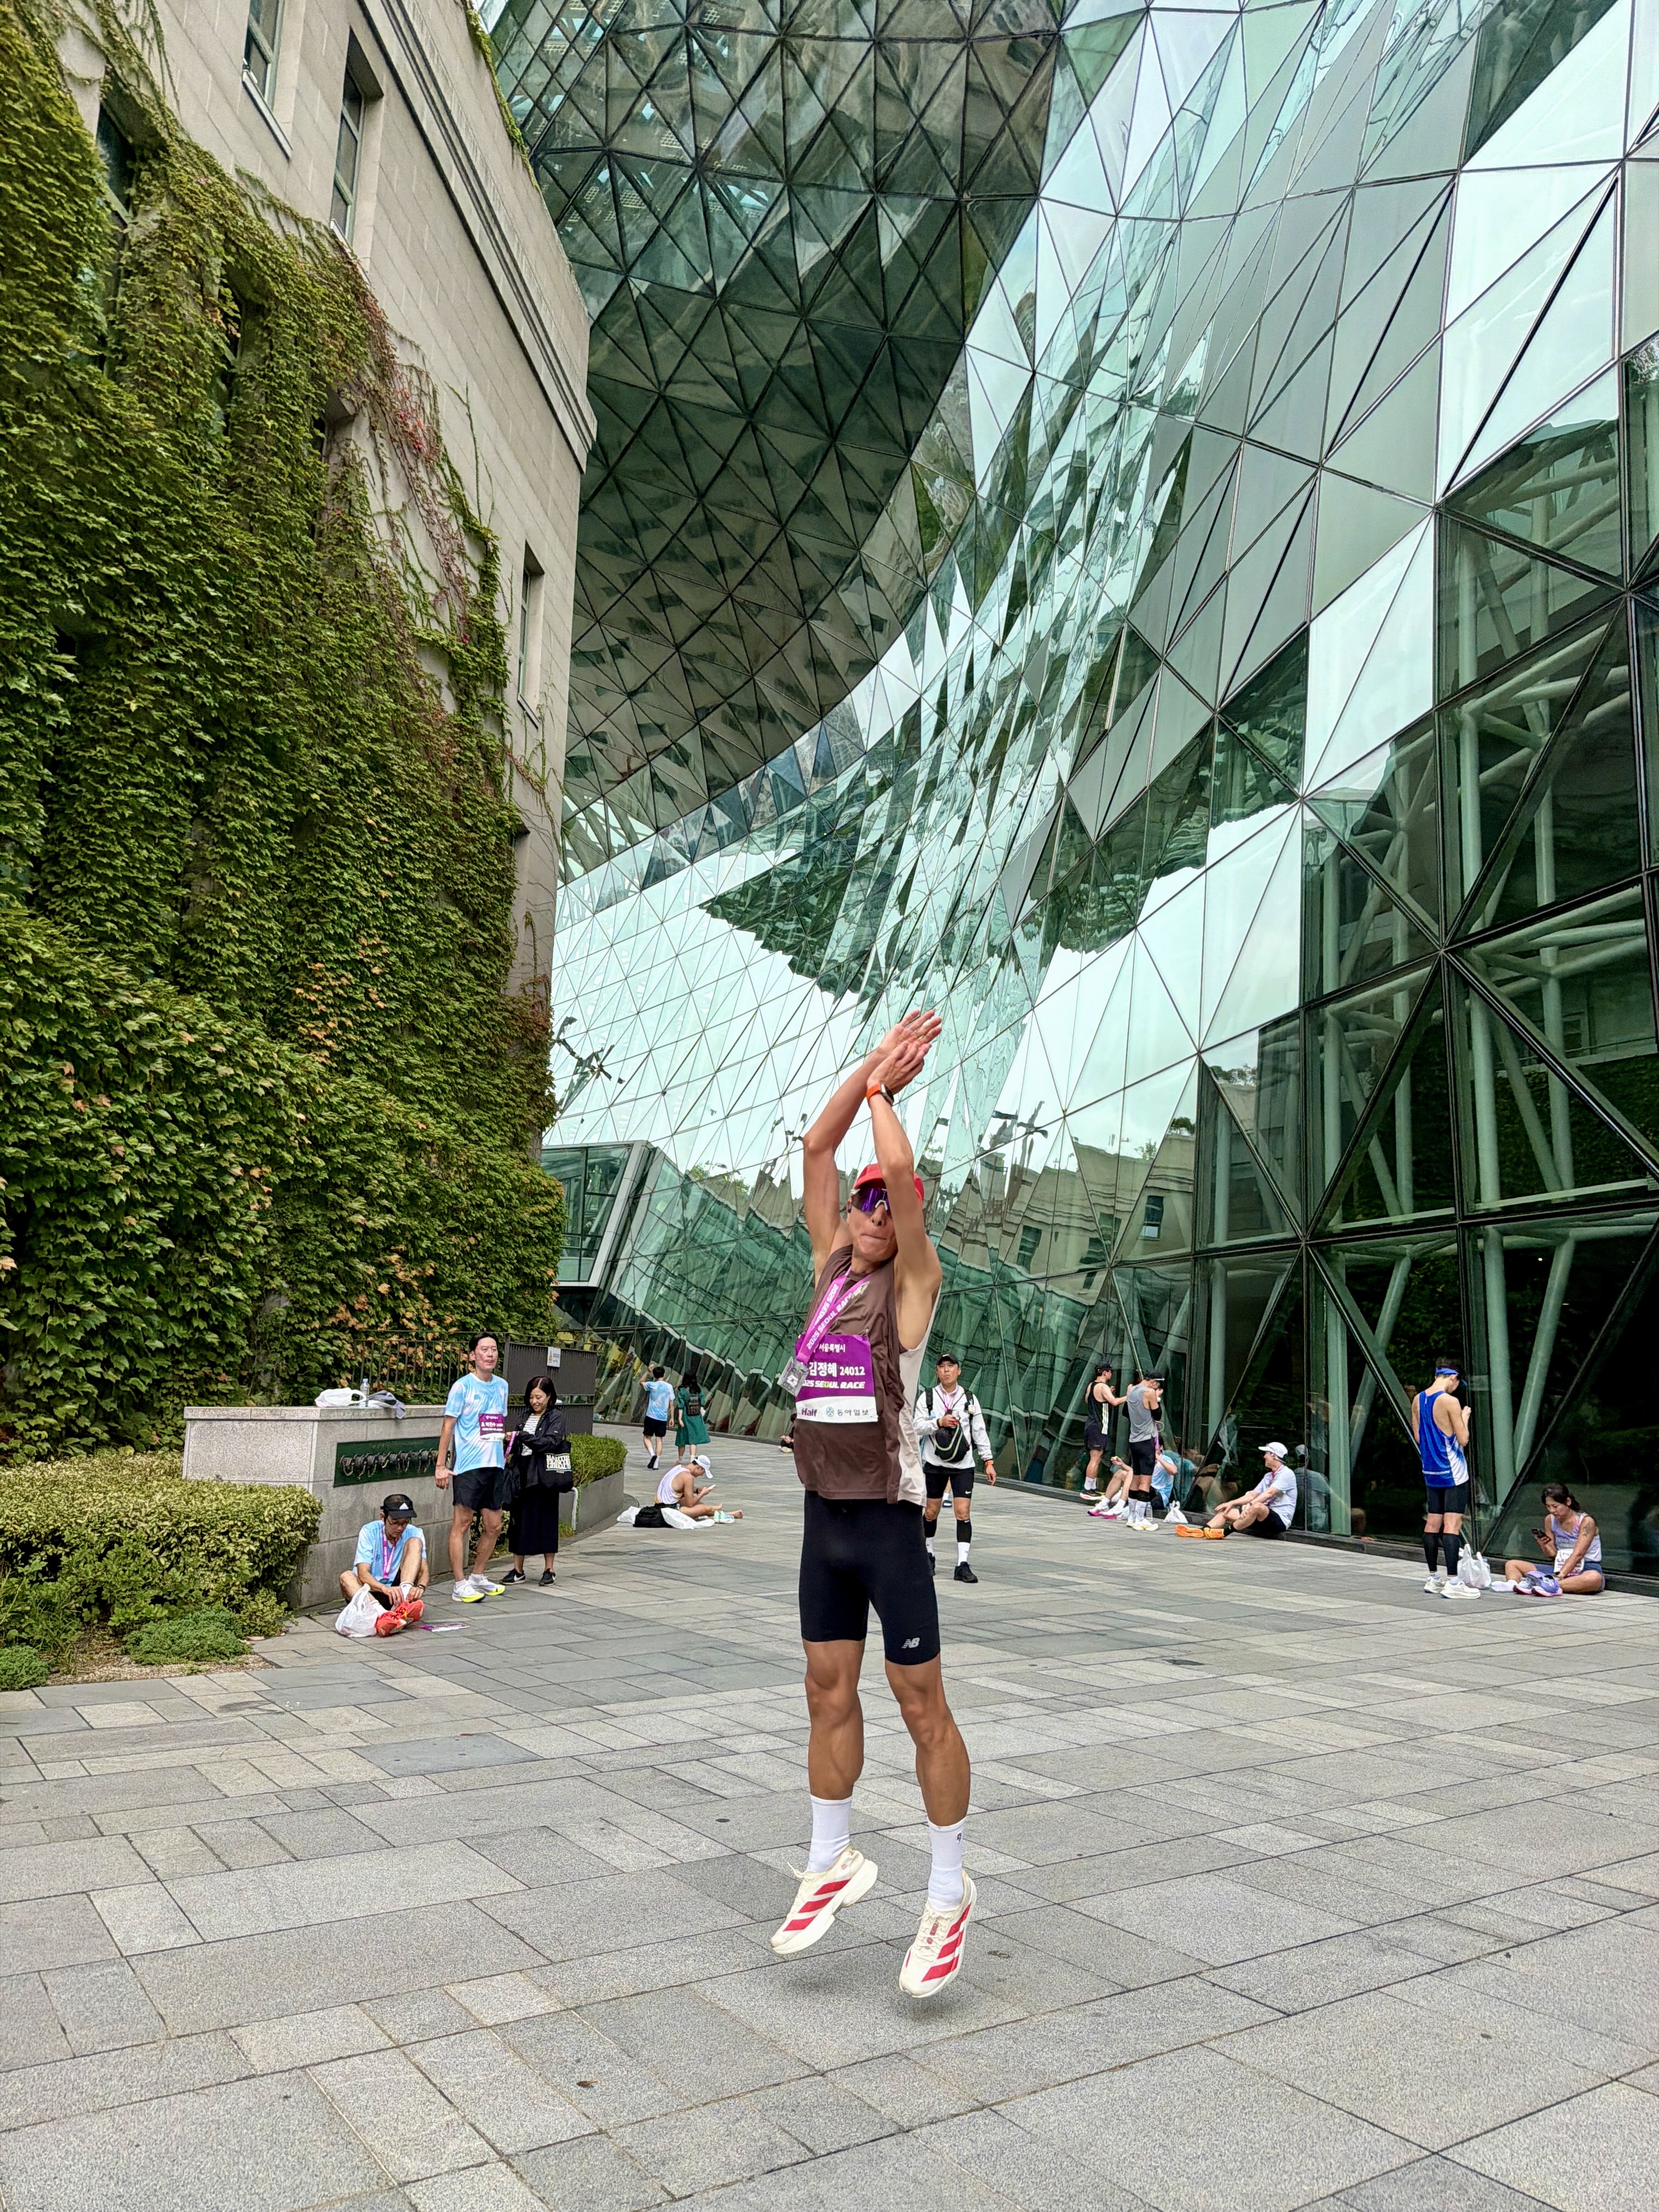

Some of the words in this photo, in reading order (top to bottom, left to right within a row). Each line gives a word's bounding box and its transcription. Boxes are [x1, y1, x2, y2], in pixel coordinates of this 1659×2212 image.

[826, 1284, 839, 1304] 2025
[806, 1330, 820, 1350] 2025
[817, 1311, 838, 1333] SEOUL
[819, 1344, 845, 1353] 서울특별시
[809, 1361, 837, 1377] 김정혜
[839, 1367, 865, 1376] 24012
[815, 1380, 839, 1389] SEOUL
[802, 1407, 817, 1417] Half
